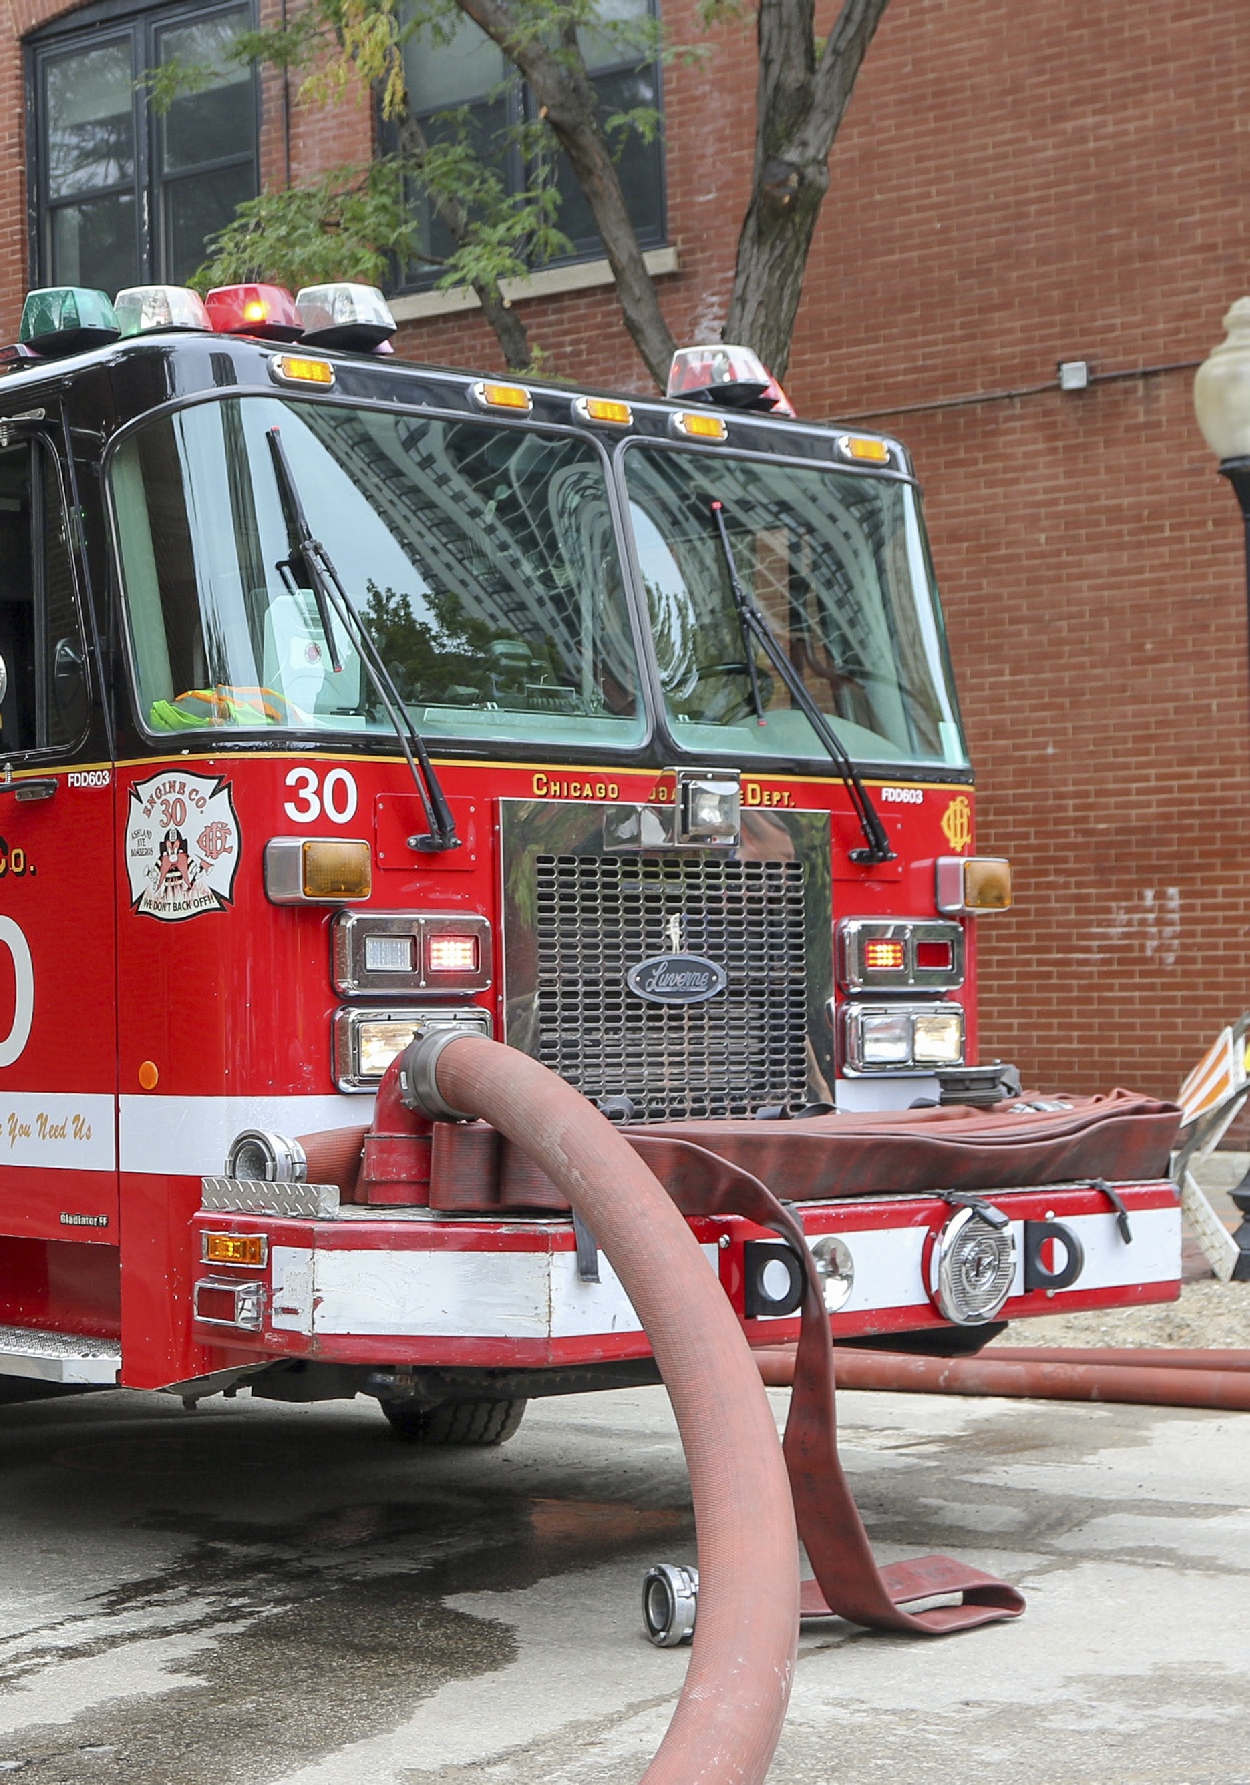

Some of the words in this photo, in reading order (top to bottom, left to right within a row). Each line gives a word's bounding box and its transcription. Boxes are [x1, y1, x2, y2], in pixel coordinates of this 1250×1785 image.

[67, 770, 110, 788] FDD603
[532, 773, 620, 800] CHICAGO
[746, 782, 796, 808] DEPT.
[142, 780, 187, 819] ENGINE
[187, 788, 208, 815] CO.
[283, 766, 358, 824] 30
[881, 787, 924, 804] FDD603
[159, 797, 187, 828] 30
[143, 898, 152, 910] WE
[153, 901, 171, 912] DON'T
[172, 900, 192, 912] BACK
[645, 961, 710, 992] Luverne
[7, 1112, 32, 1149] You
[36, 1112, 69, 1140] Need
[72, 1113, 93, 1141] Us
[60, 1213, 97, 1227] Gladiator
